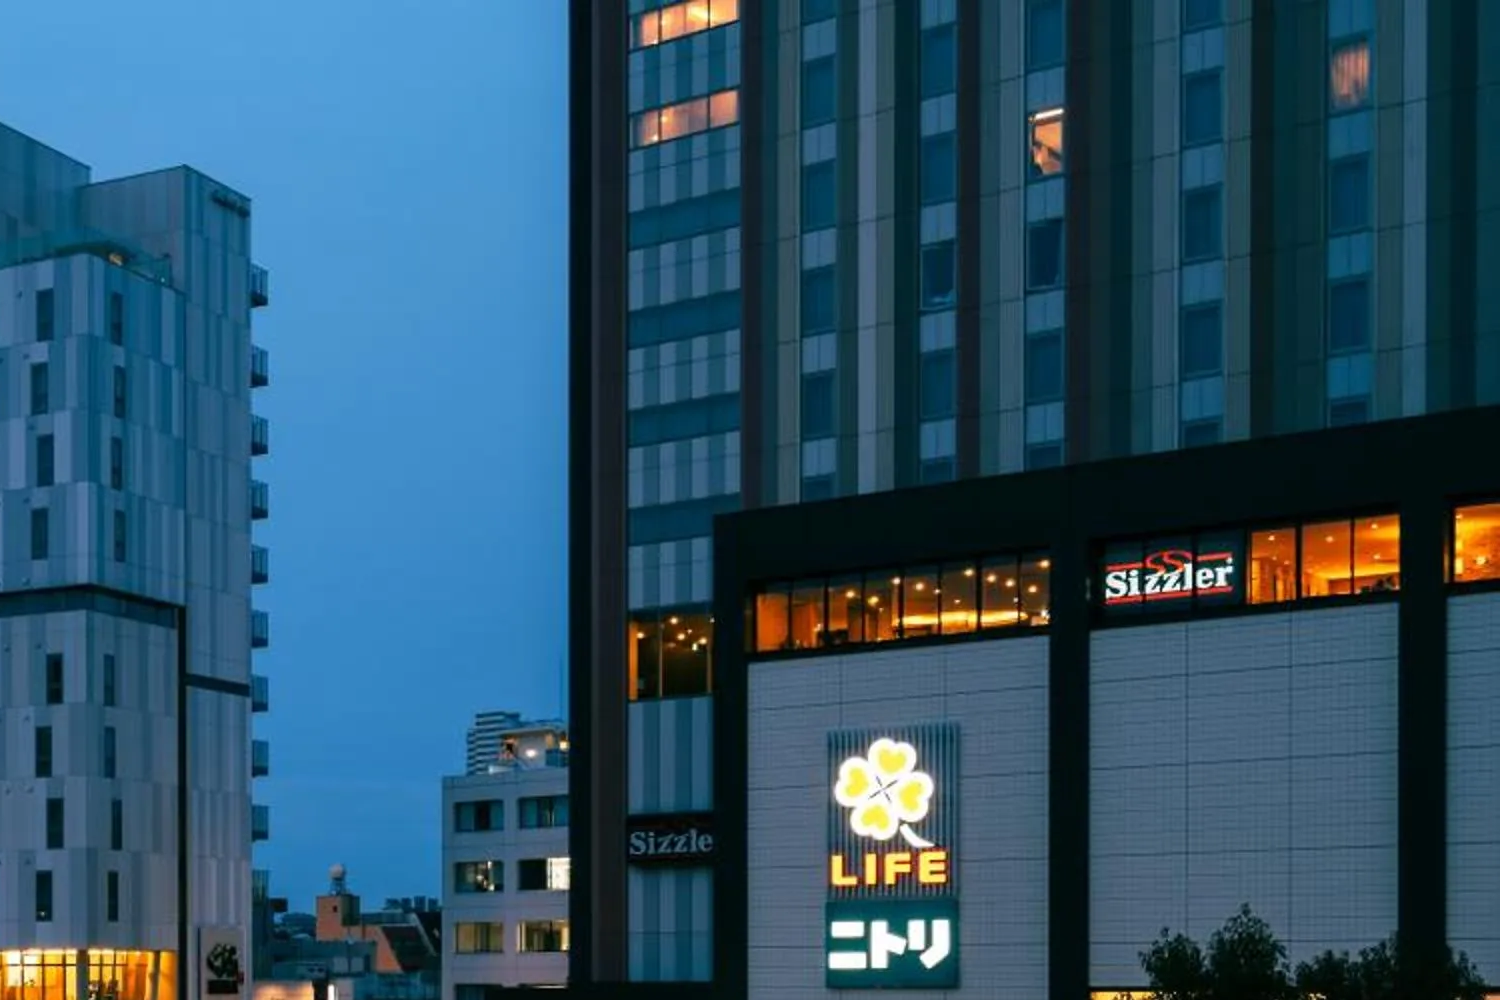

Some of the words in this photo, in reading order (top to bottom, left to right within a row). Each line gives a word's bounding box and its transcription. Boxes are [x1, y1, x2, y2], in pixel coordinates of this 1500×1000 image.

[1105, 557, 1233, 599] Sizzler
[830, 850, 948, 886] LIFE
[828, 918, 950, 970] ニトリ
